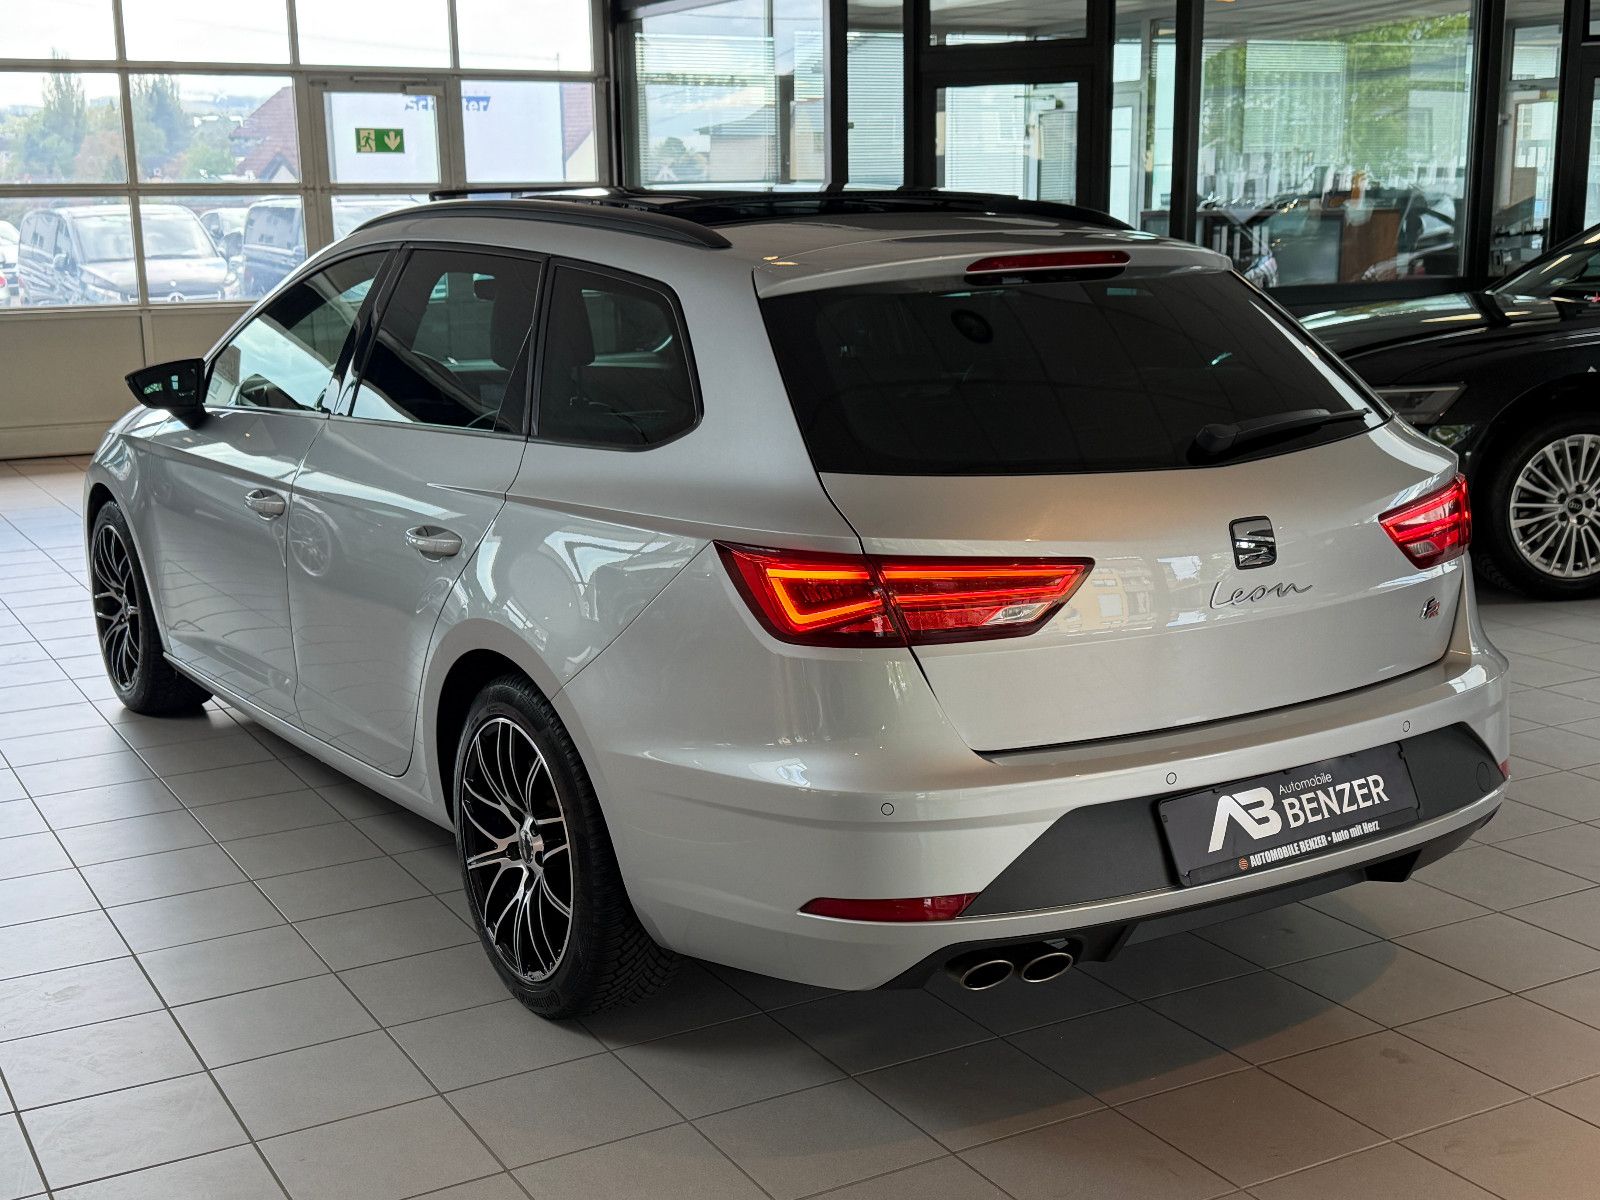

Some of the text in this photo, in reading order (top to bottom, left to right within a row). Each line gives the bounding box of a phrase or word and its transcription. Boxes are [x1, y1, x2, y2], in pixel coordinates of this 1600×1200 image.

[1210, 581, 1312, 610] Leon
[1279, 772, 1333, 795] Automobile
[1281, 774, 1390, 829] BENZER
[1250, 820, 1380, 868] AUTOMOBILE BENZER Auto mit Herz
